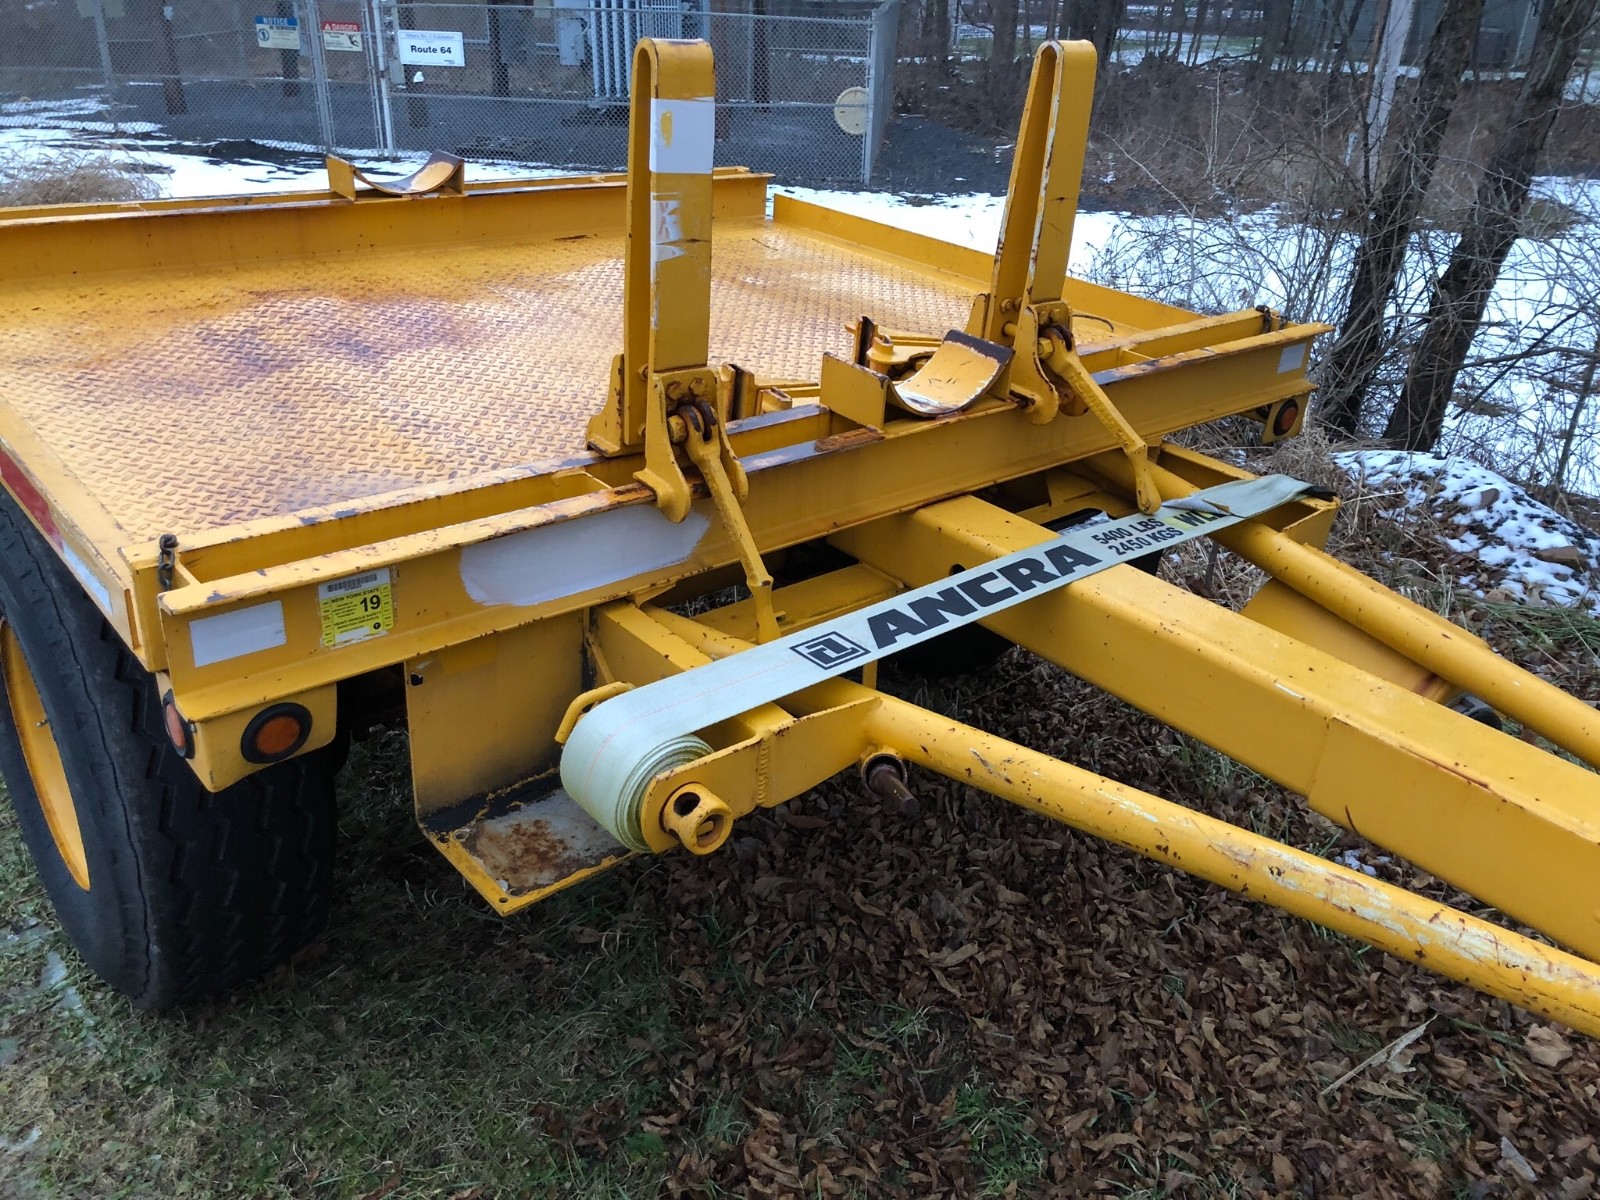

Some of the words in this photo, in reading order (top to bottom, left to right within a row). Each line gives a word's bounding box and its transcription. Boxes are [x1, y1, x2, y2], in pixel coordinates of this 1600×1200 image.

[263, 17, 289, 26] NOTICE
[331, 23, 358, 32] DANGER
[410, 45, 438, 54] Route
[440, 46, 452, 54] 64
[1091, 527, 1133, 545] 5400
[1129, 518, 1166, 533] LBS
[1108, 536, 1153, 556] 2450
[1147, 527, 1185, 542] KGS
[346, 592, 362, 600] YORK
[362, 587, 380, 596] STATE
[867, 544, 1103, 650] ANCRA
[360, 594, 381, 612] 19
